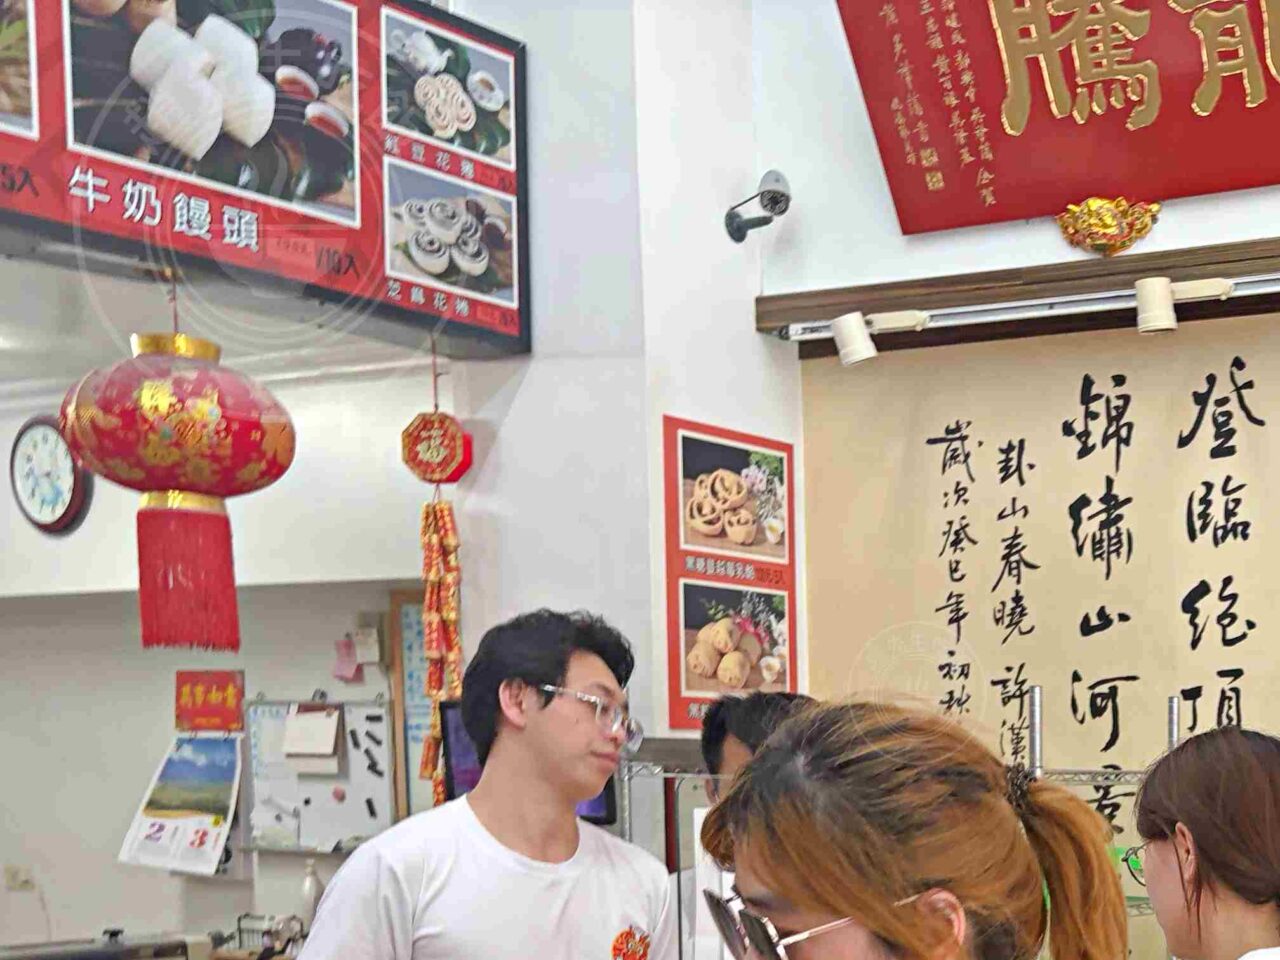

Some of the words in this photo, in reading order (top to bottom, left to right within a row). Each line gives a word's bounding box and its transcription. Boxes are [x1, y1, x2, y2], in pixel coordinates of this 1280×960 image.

[68, 164, 261, 253] 牛奶饅頭
[145, 821, 167, 843] 2
[189, 828, 209, 849] 3
